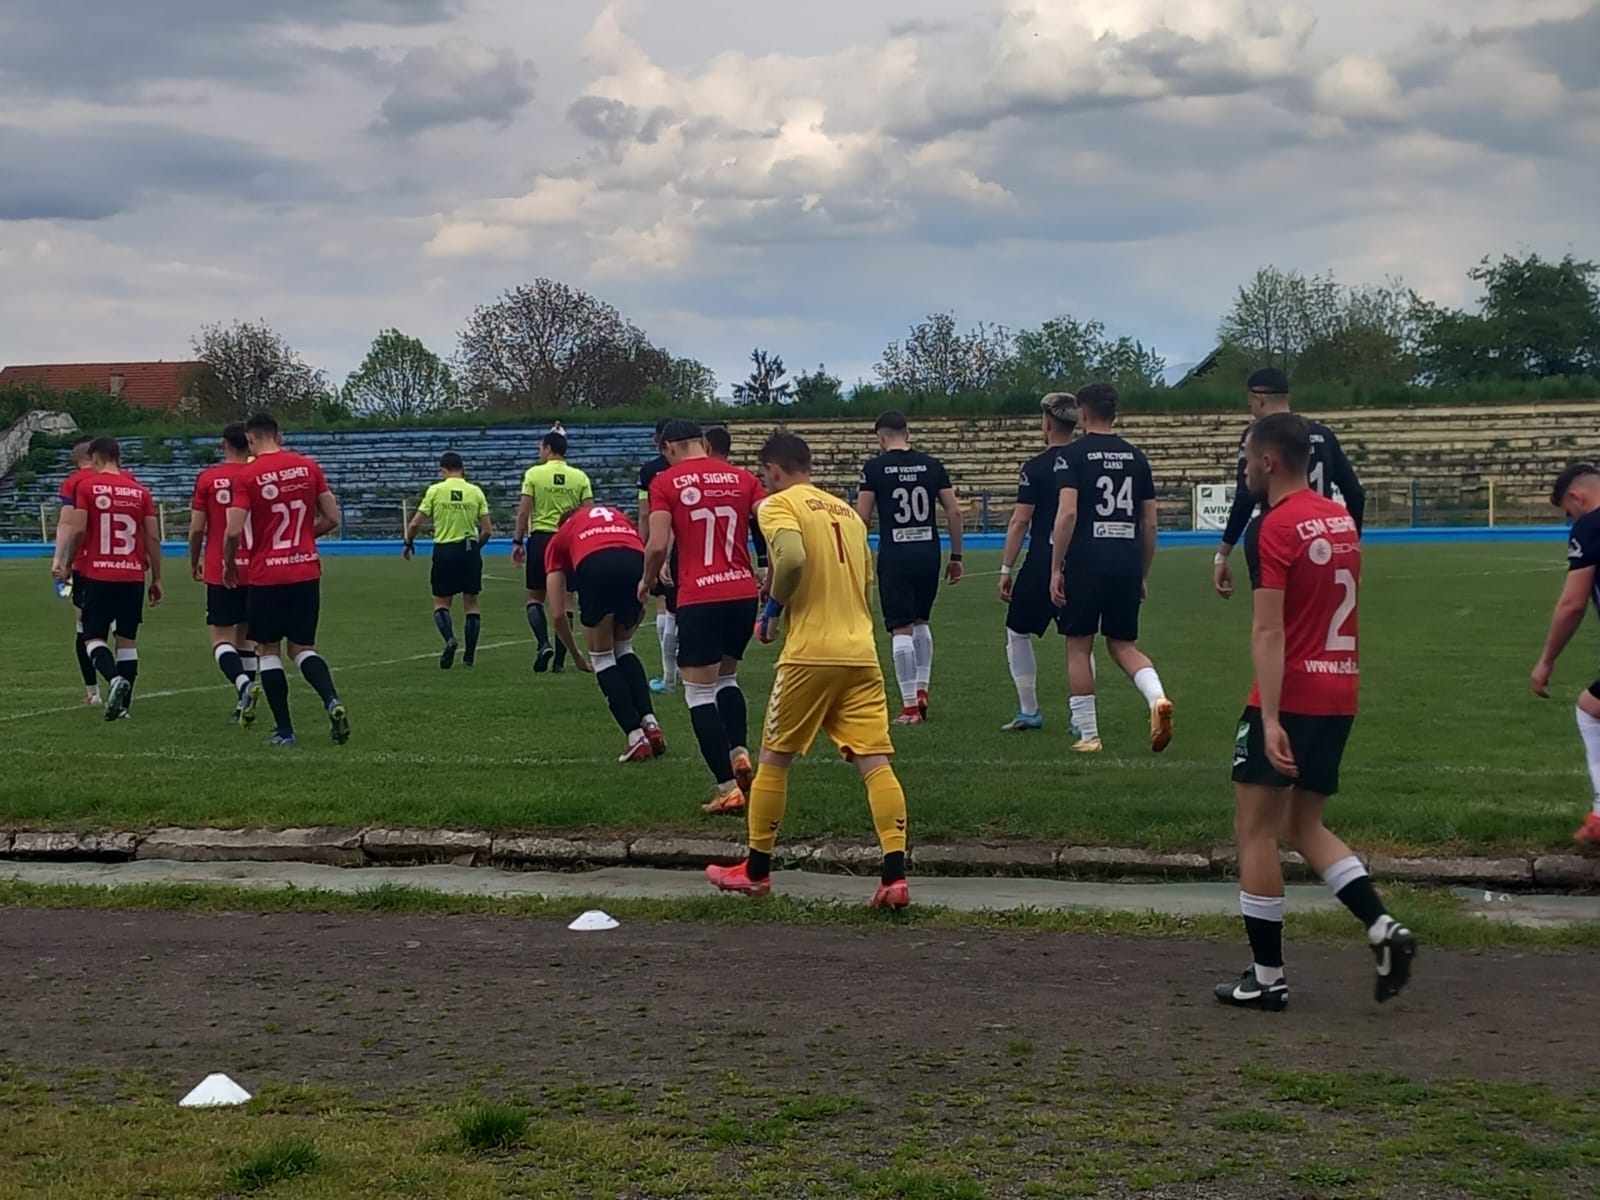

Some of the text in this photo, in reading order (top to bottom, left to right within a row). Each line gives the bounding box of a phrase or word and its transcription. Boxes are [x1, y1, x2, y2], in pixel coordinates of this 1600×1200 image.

[1104, 452, 1134, 461] VICTORIA
[279, 466, 309, 481] SIGHET
[899, 464, 927, 473] VICTORIA
[673, 472, 740, 489] CSM SIGHET
[92, 485, 143, 500] CSM SIGHET
[704, 489, 742, 497] EDAC
[1095, 475, 1133, 517] 34
[589, 507, 614, 522] 4
[892, 486, 930, 523] 30
[100, 512, 137, 556] 13
[271, 499, 307, 550] 27
[1296, 518, 1328, 541] CSM
[690, 505, 738, 567] 77
[831, 522, 845, 564] 1
[1332, 543, 1361, 553] EDA
[1325, 569, 1356, 651] 2
